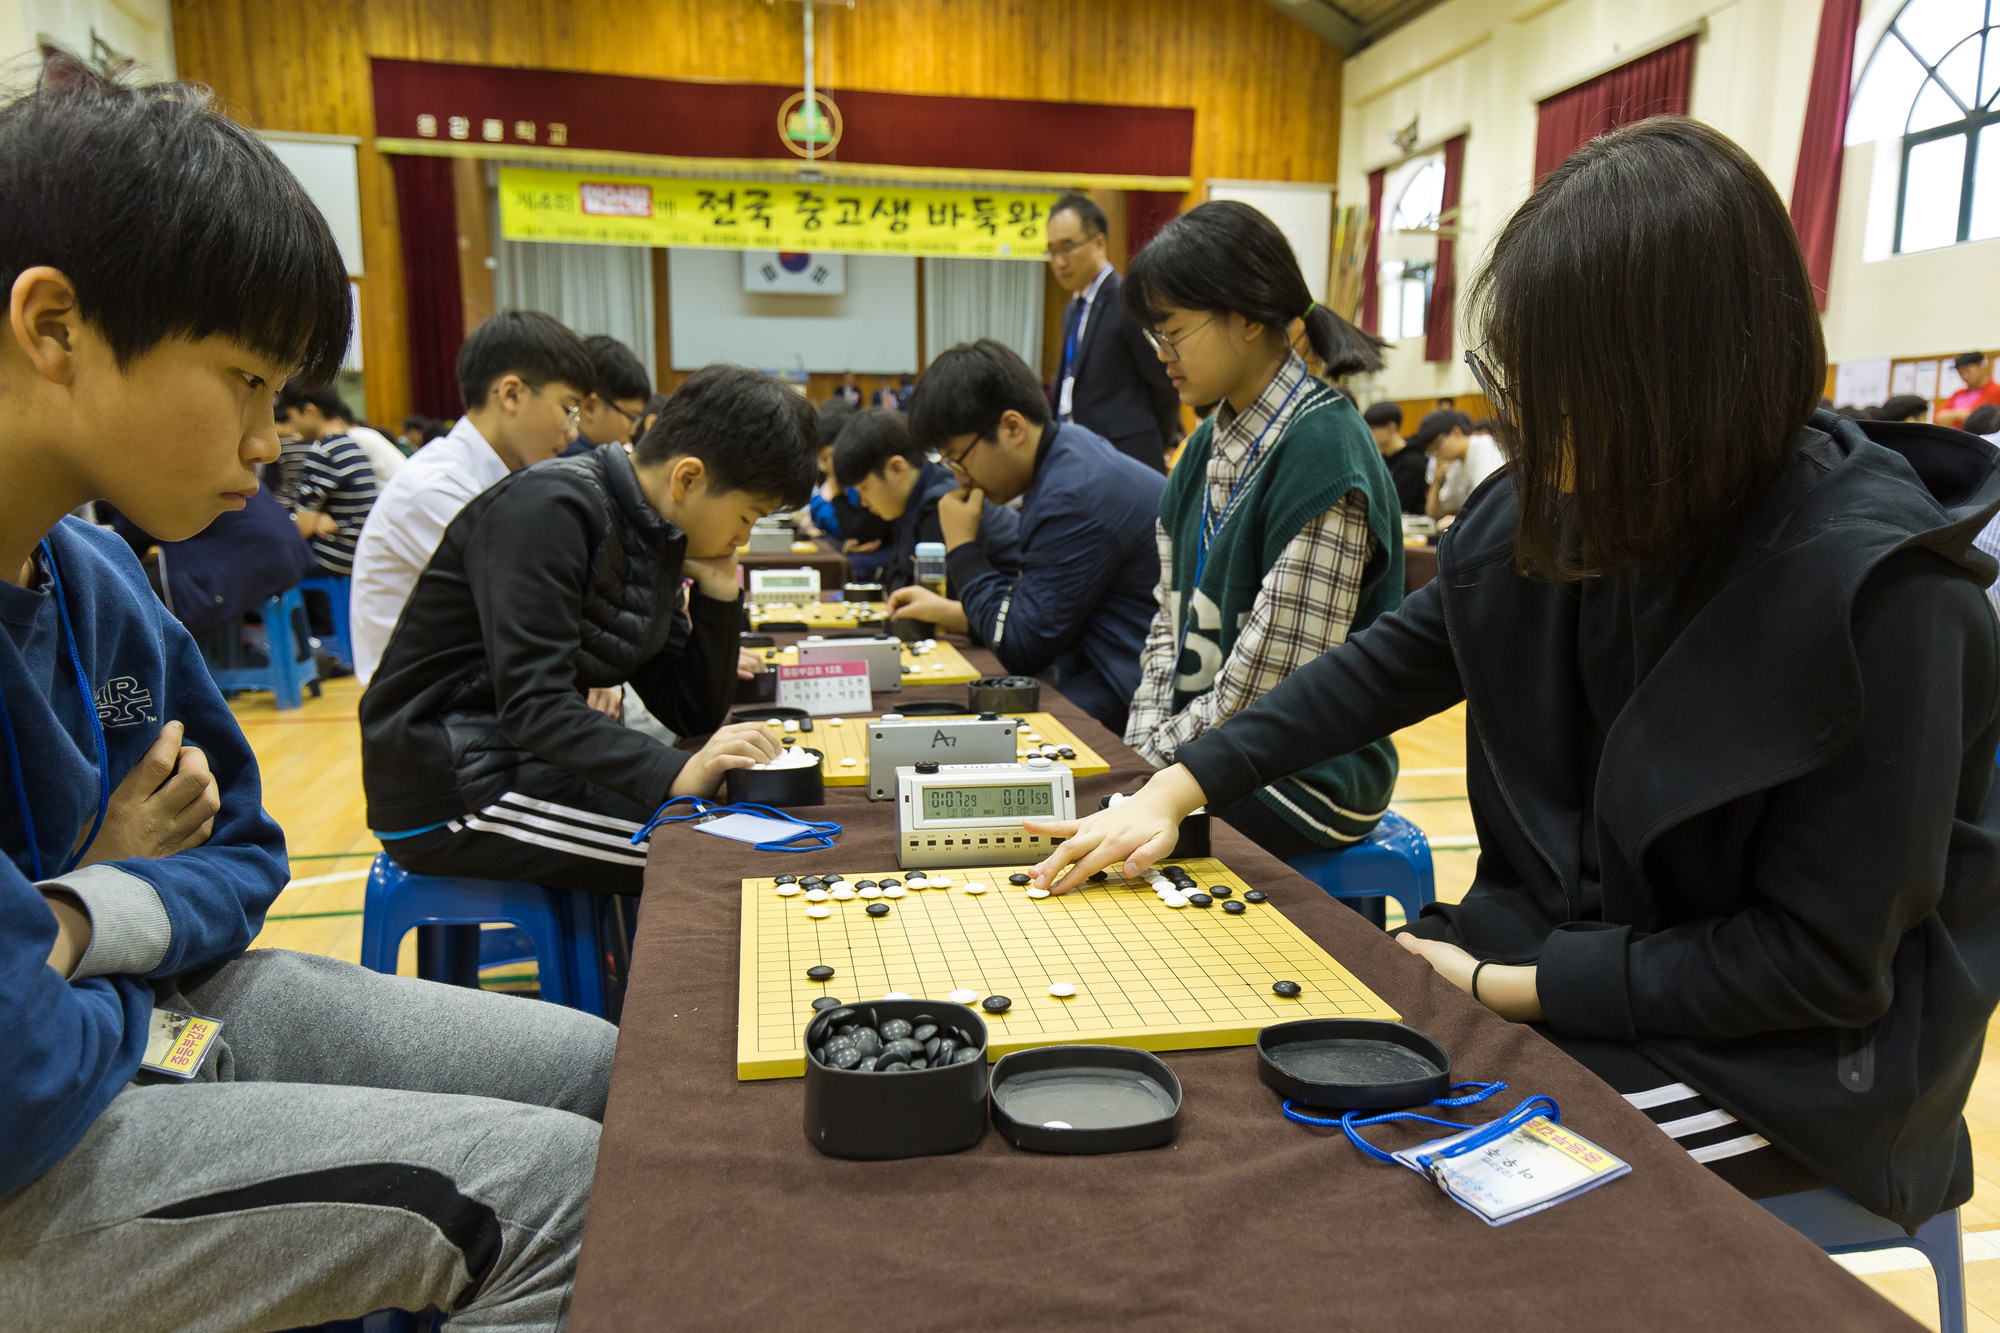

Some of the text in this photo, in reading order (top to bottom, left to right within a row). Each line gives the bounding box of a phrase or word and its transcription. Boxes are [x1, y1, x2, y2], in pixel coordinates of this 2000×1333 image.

[697, 190, 771, 229] 전국
[795, 190, 911, 233] 중고생
[928, 197, 1042, 239] 바둑왕
[931, 729, 957, 748] A7
[170, 1023, 208, 1066] 중등부갑조
[1524, 1119, 1603, 1164] 중등부갑조
